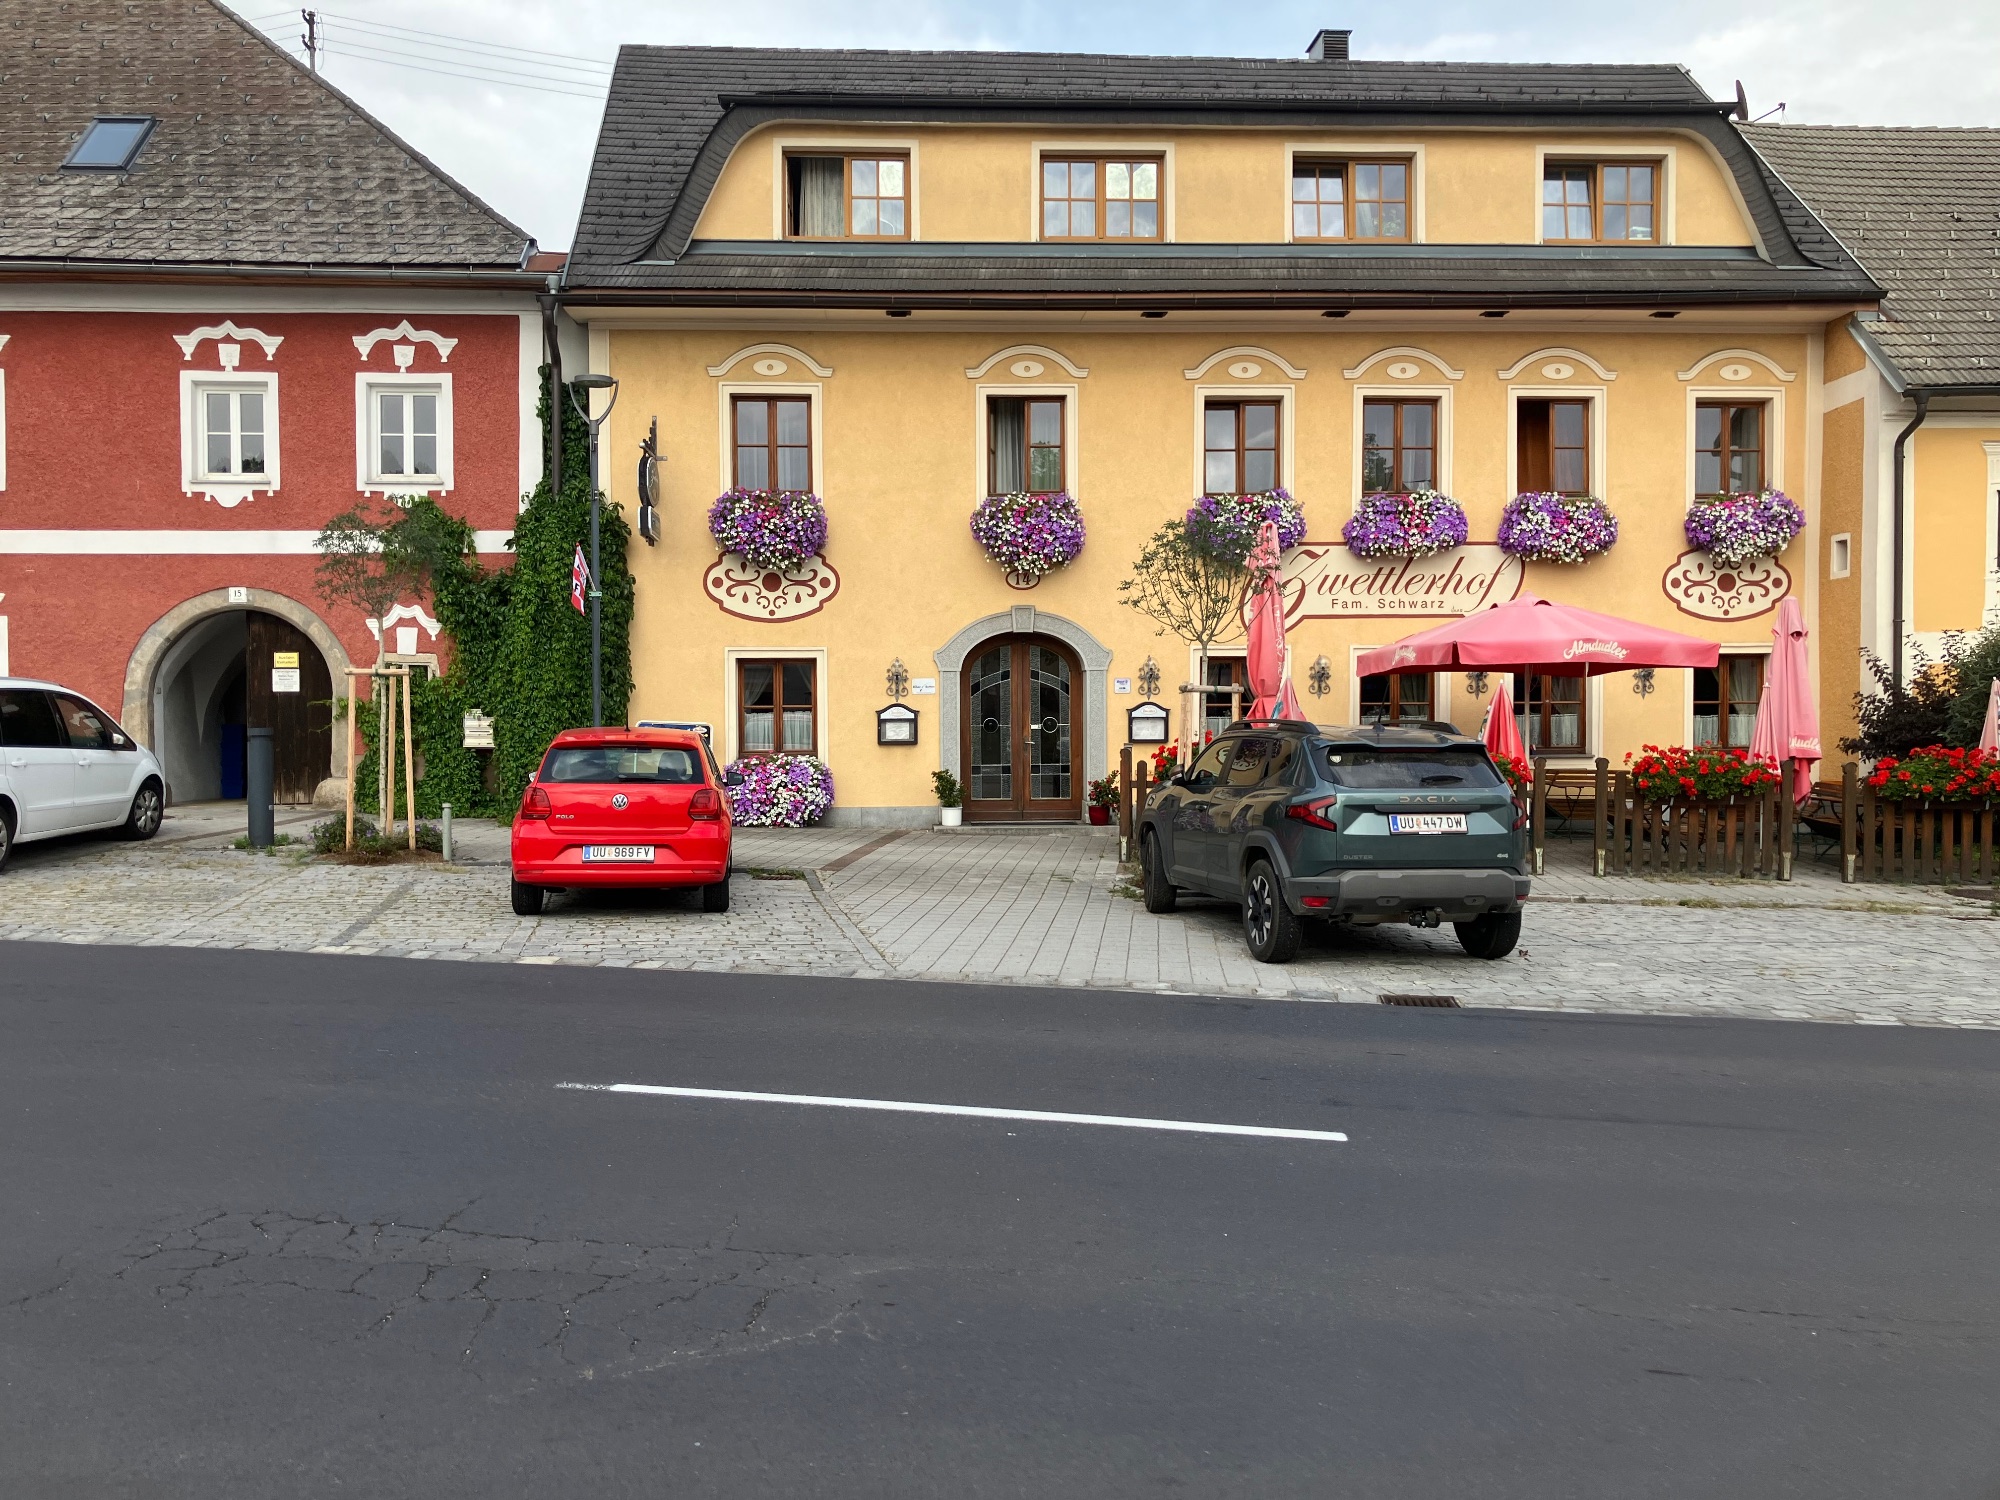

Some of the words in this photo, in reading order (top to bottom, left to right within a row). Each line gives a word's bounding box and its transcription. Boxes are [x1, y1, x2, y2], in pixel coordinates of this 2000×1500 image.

[1015, 571, 1031, 586] 14
[1281, 548, 1516, 619] Zwettlerhof
[233, 589, 242, 598] 15
[1331, 598, 1369, 609] Fam.
[1377, 598, 1445, 609] Schwarz
[1563, 639, 1628, 660] Almdudler
[1400, 817, 1415, 829] UU
[1423, 817, 1443, 829] 447
[1446, 817, 1462, 829] DW
[592, 847, 607, 858] UU
[614, 847, 635, 858] 969
